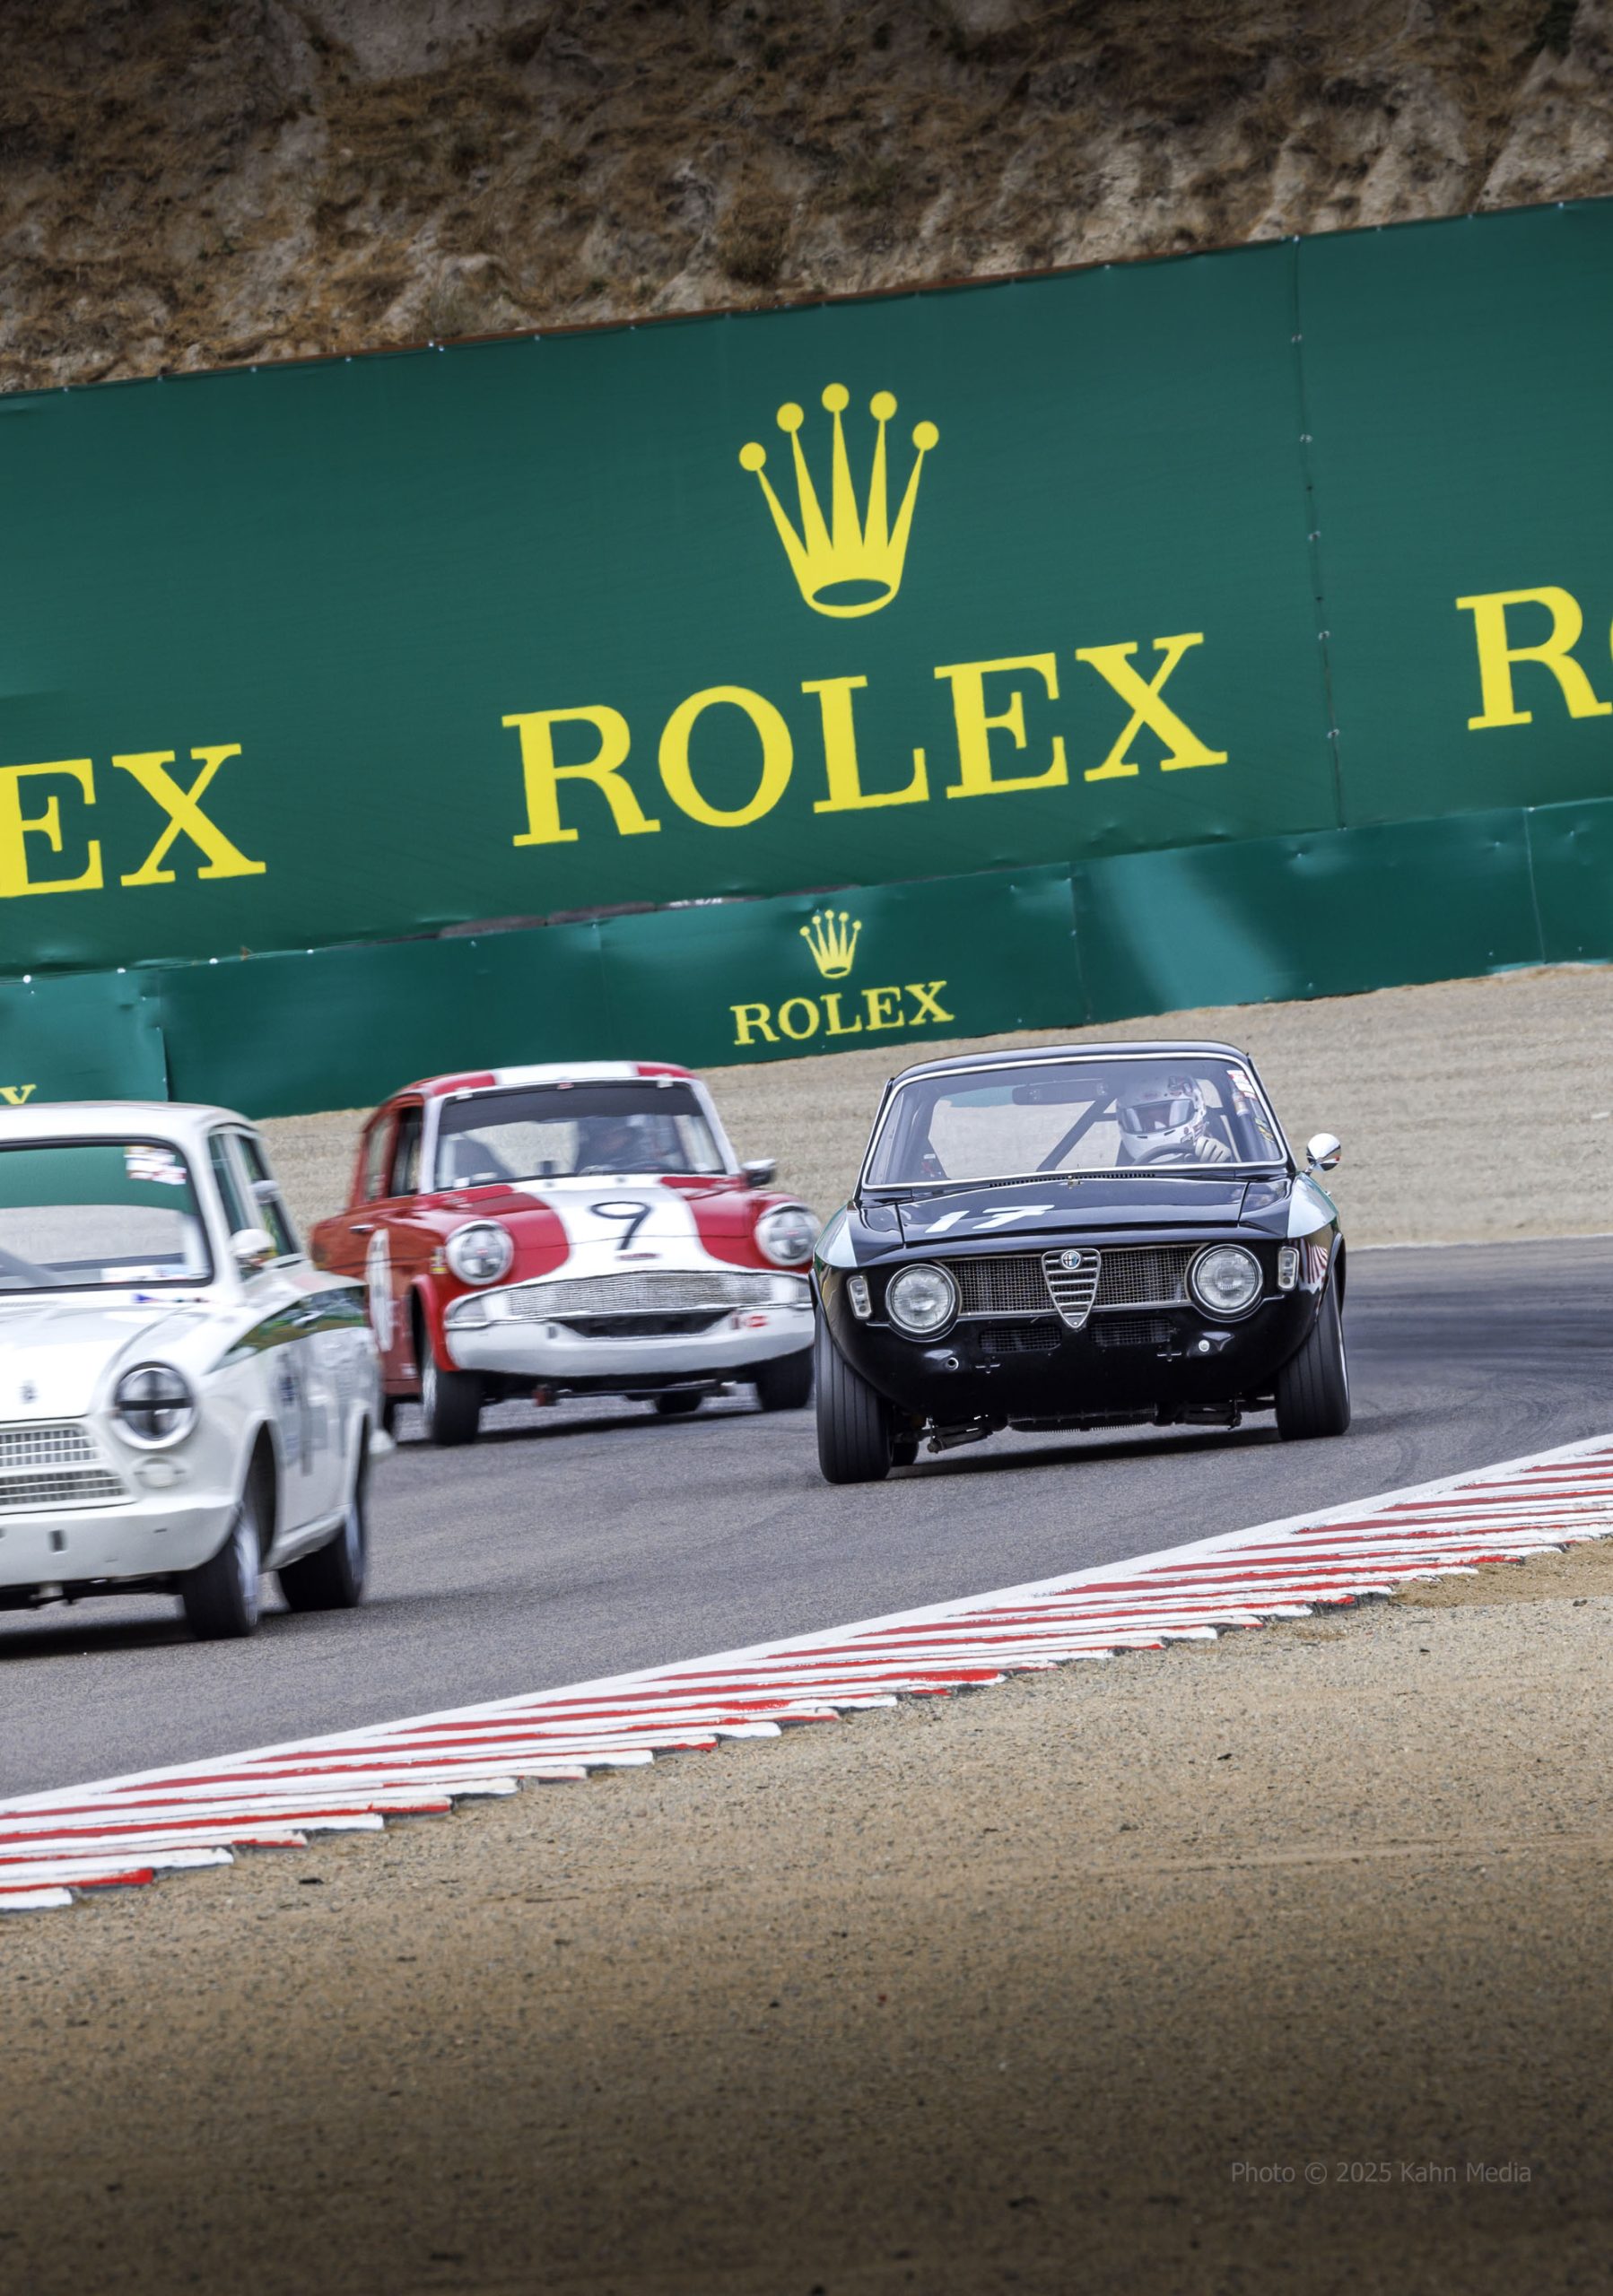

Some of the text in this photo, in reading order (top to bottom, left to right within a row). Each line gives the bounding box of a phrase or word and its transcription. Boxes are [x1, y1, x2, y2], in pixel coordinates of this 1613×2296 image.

[1455, 586, 1613, 731] R
[501, 633, 1227, 848] ROLEX
[729, 980, 955, 1046] ROLEX
[589, 1200, 654, 1251] 9
[924, 1204, 1056, 1234] 17
